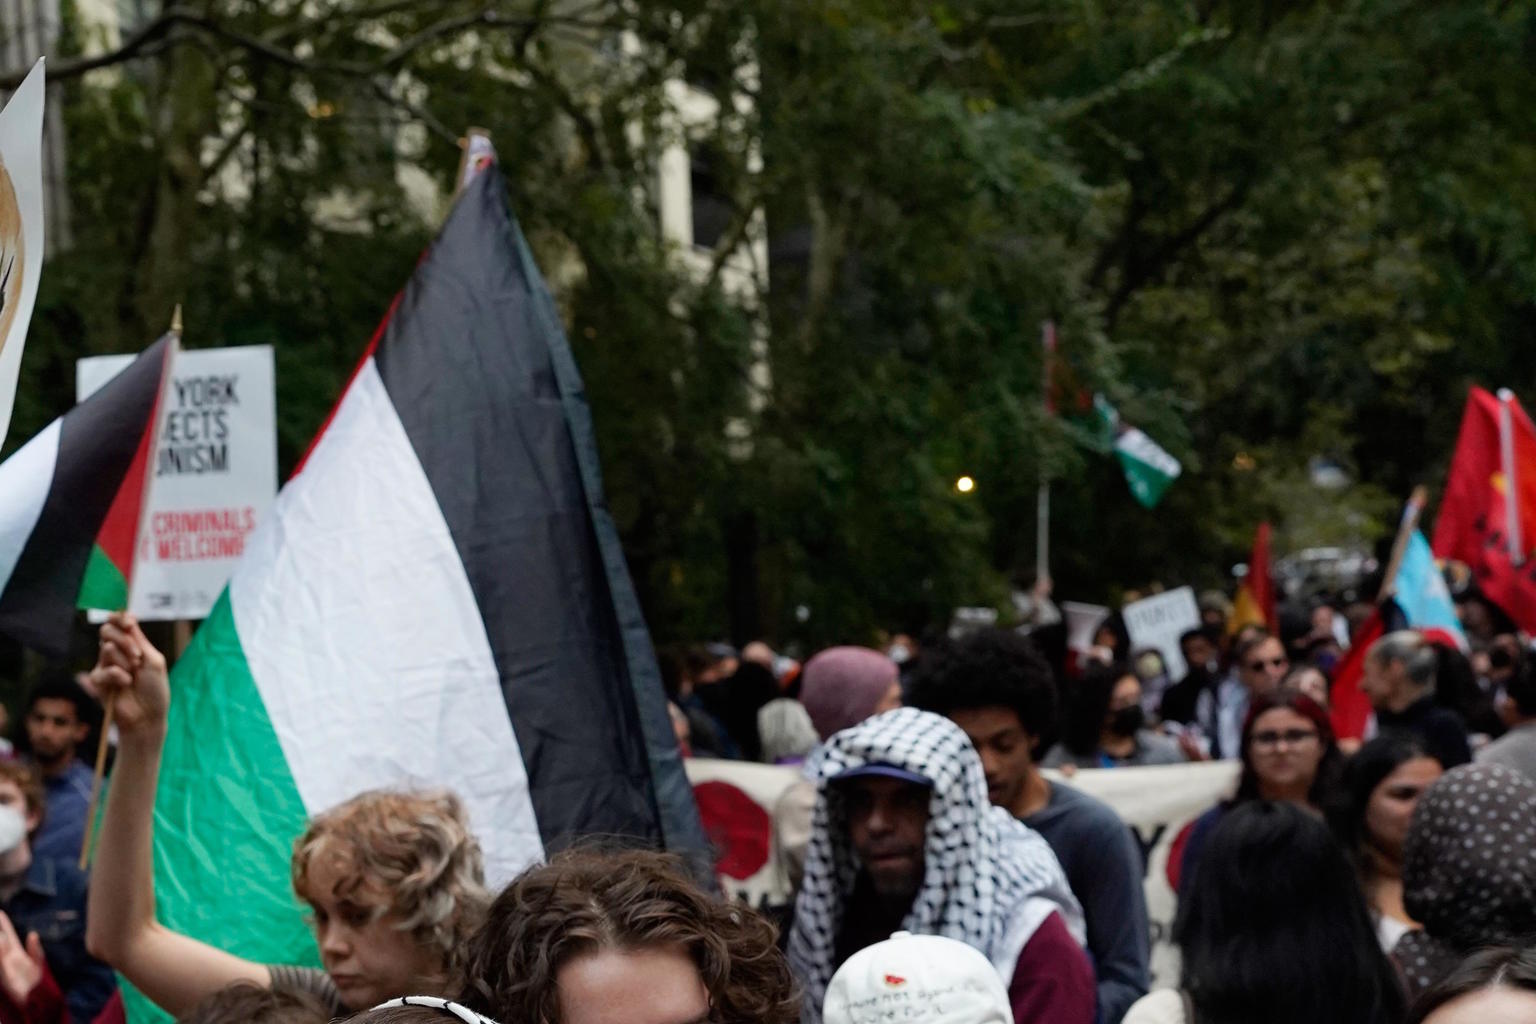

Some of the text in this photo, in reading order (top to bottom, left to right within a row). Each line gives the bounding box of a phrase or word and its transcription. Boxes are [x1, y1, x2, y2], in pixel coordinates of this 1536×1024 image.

[173, 373, 240, 407] YORK
[164, 409, 230, 442] ECTS
[151, 506, 255, 537] CRIMINALS
